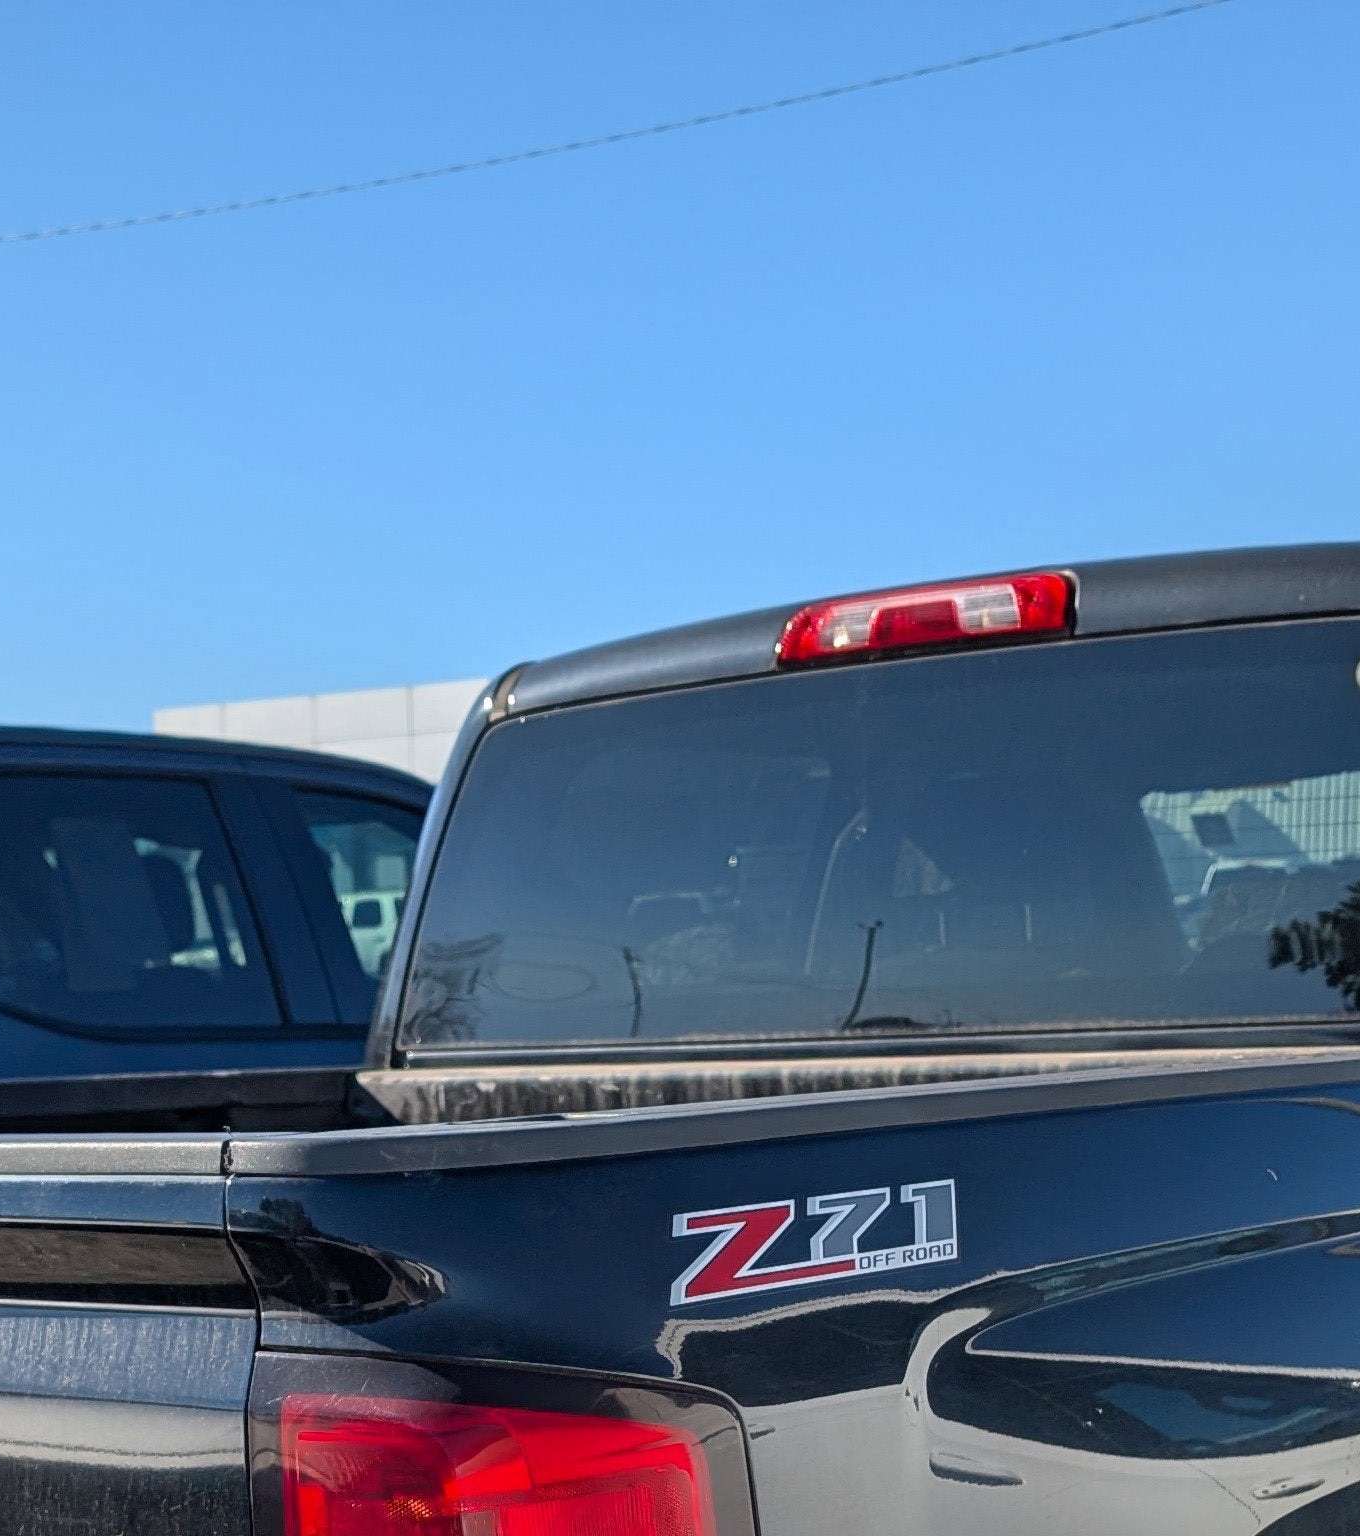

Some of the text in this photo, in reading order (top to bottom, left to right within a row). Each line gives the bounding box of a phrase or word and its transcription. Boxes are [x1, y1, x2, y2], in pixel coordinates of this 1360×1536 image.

[669, 1178, 958, 1307] Z71
[859, 1243, 954, 1269] OFF ROAD
